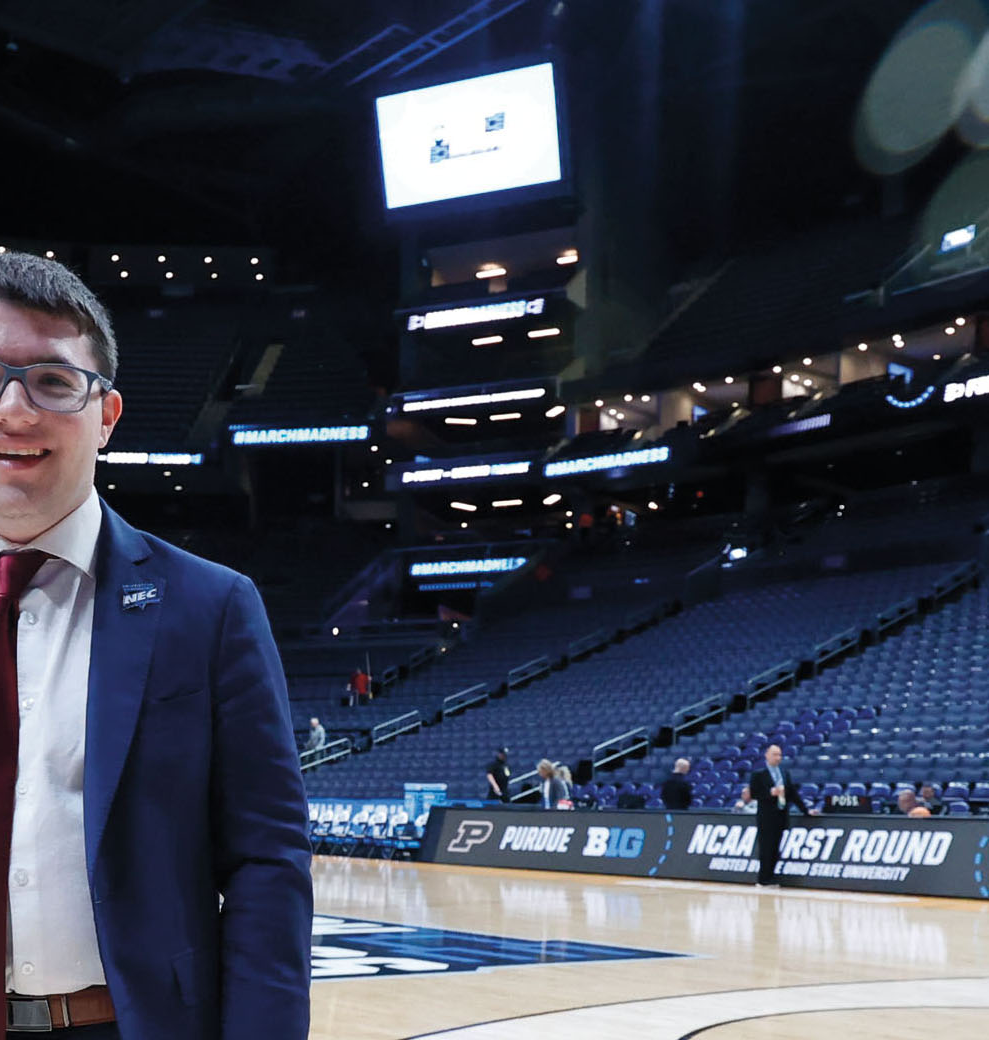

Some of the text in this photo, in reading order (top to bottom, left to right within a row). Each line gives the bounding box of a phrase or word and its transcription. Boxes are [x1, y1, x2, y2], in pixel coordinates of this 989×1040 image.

[123, 588, 157, 605] NEC
[499, 826, 575, 853] PURDUE
[687, 824, 953, 865] NCAA IRST ROUND
[709, 857, 748, 871] HOSTED
[809, 863, 843, 878] STATE
[842, 865, 911, 881] UNIVERSITY
